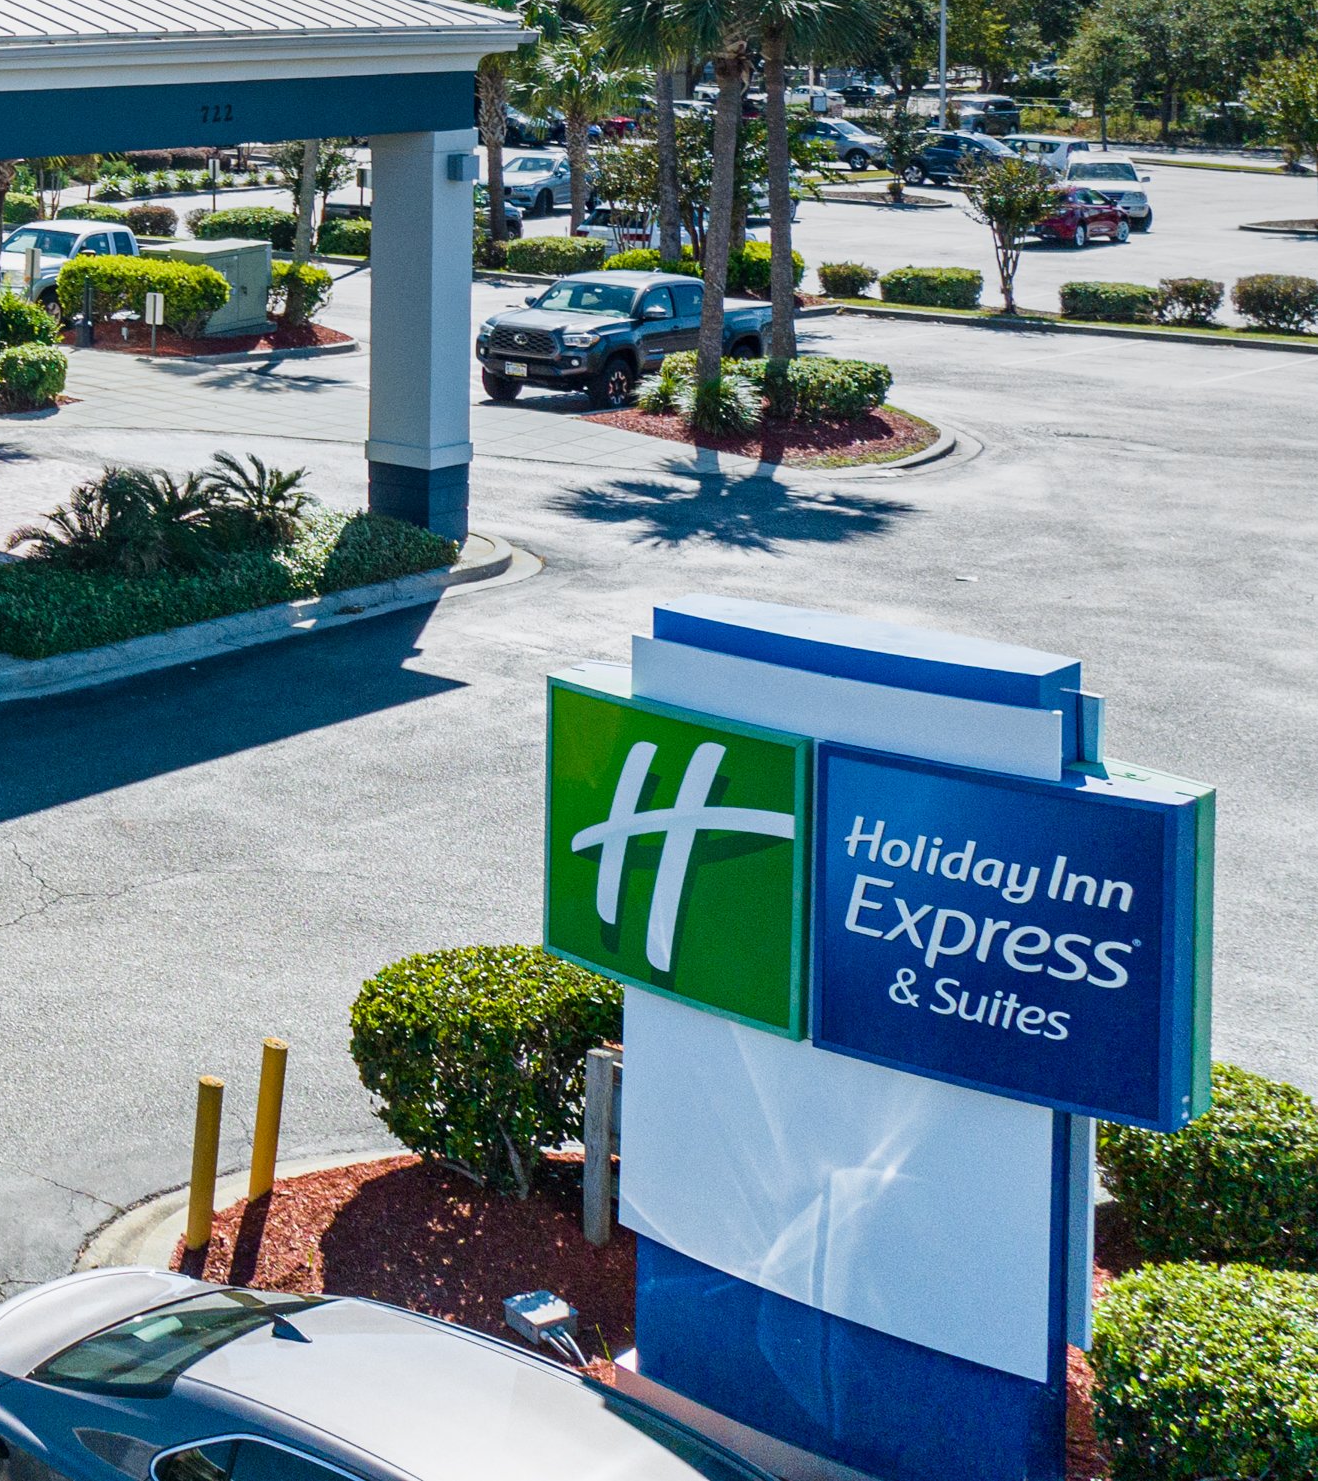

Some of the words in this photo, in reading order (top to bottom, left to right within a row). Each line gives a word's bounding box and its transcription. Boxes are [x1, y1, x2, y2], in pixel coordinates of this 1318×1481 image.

[200, 104, 233, 123] 722
[844, 815, 1040, 904] Holiday
[1047, 855, 1134, 913] Inn
[888, 967, 920, 1008] &
[929, 977, 1071, 1041] Suites
